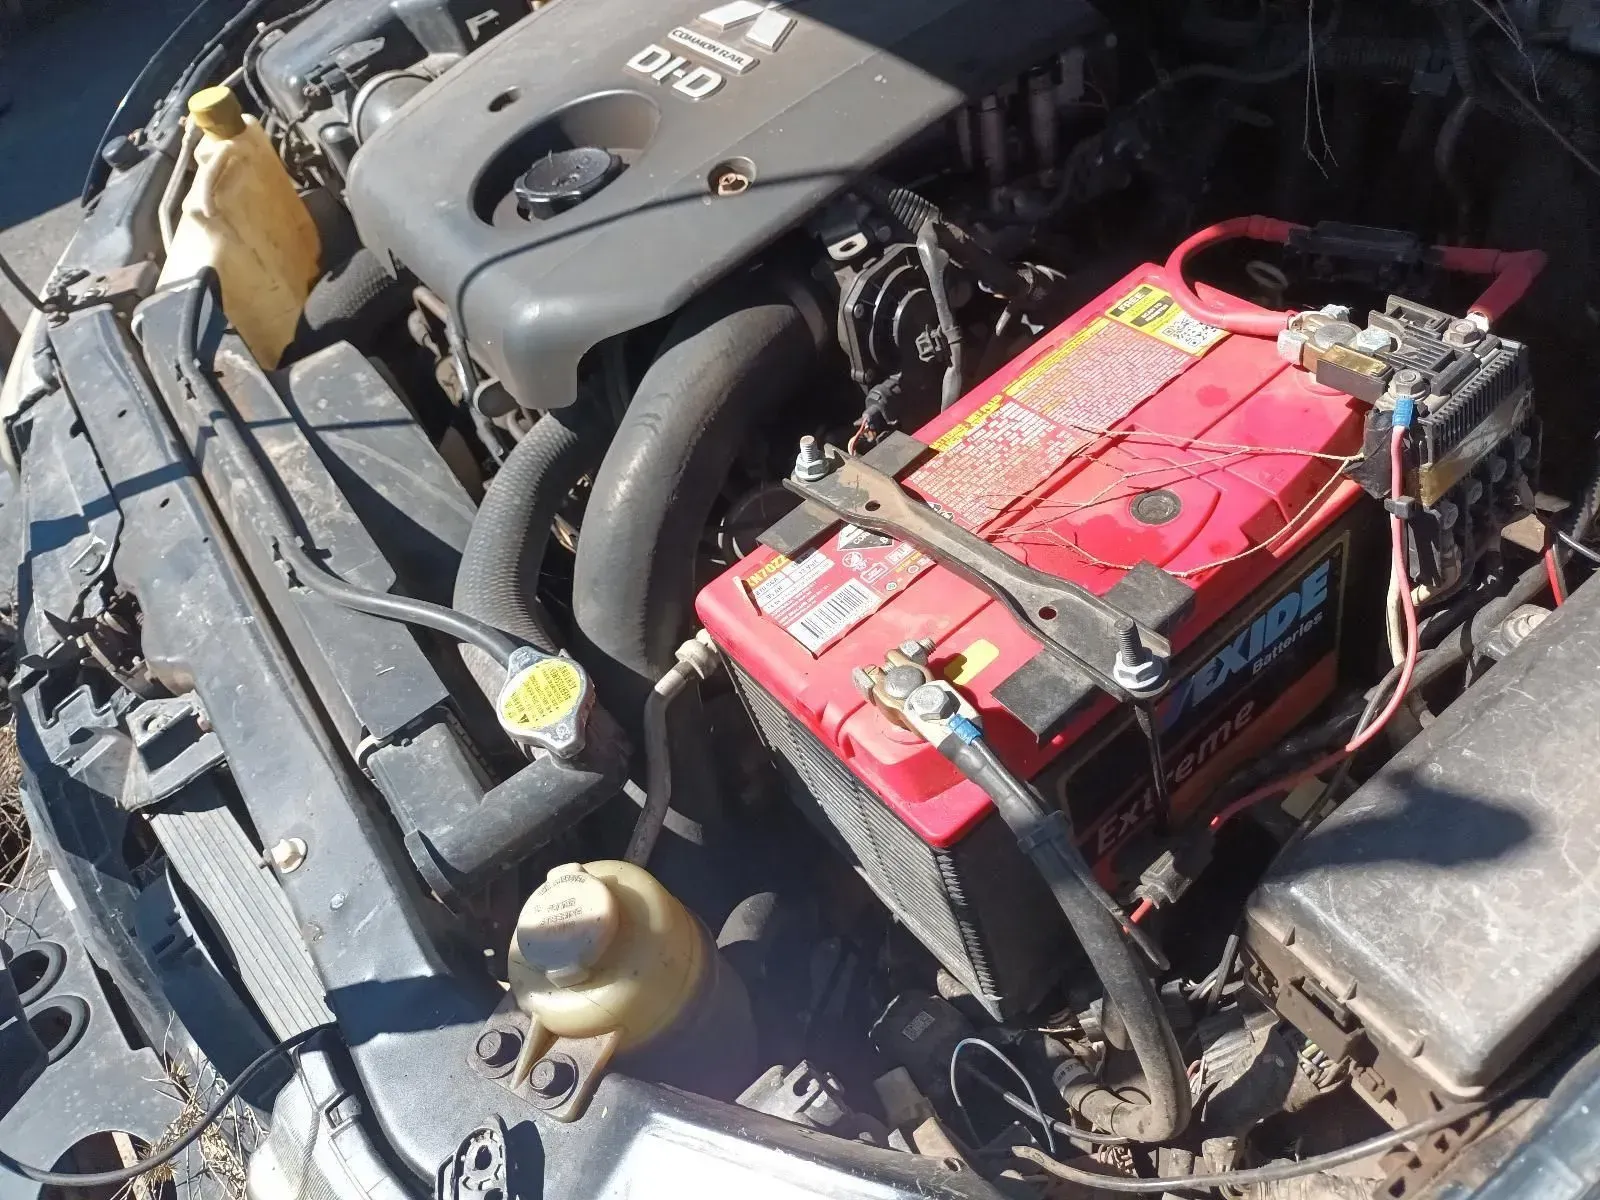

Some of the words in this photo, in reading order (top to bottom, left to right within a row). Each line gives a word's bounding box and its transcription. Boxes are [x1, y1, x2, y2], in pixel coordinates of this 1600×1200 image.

[626, 44, 722, 98] DI-D
[672, 29, 720, 53] COMMON
[718, 50, 745, 66] RAIL
[1118, 292, 1144, 312] FREE
[1190, 558, 1330, 708] EXIDE
[1252, 611, 1324, 676] Batteries
